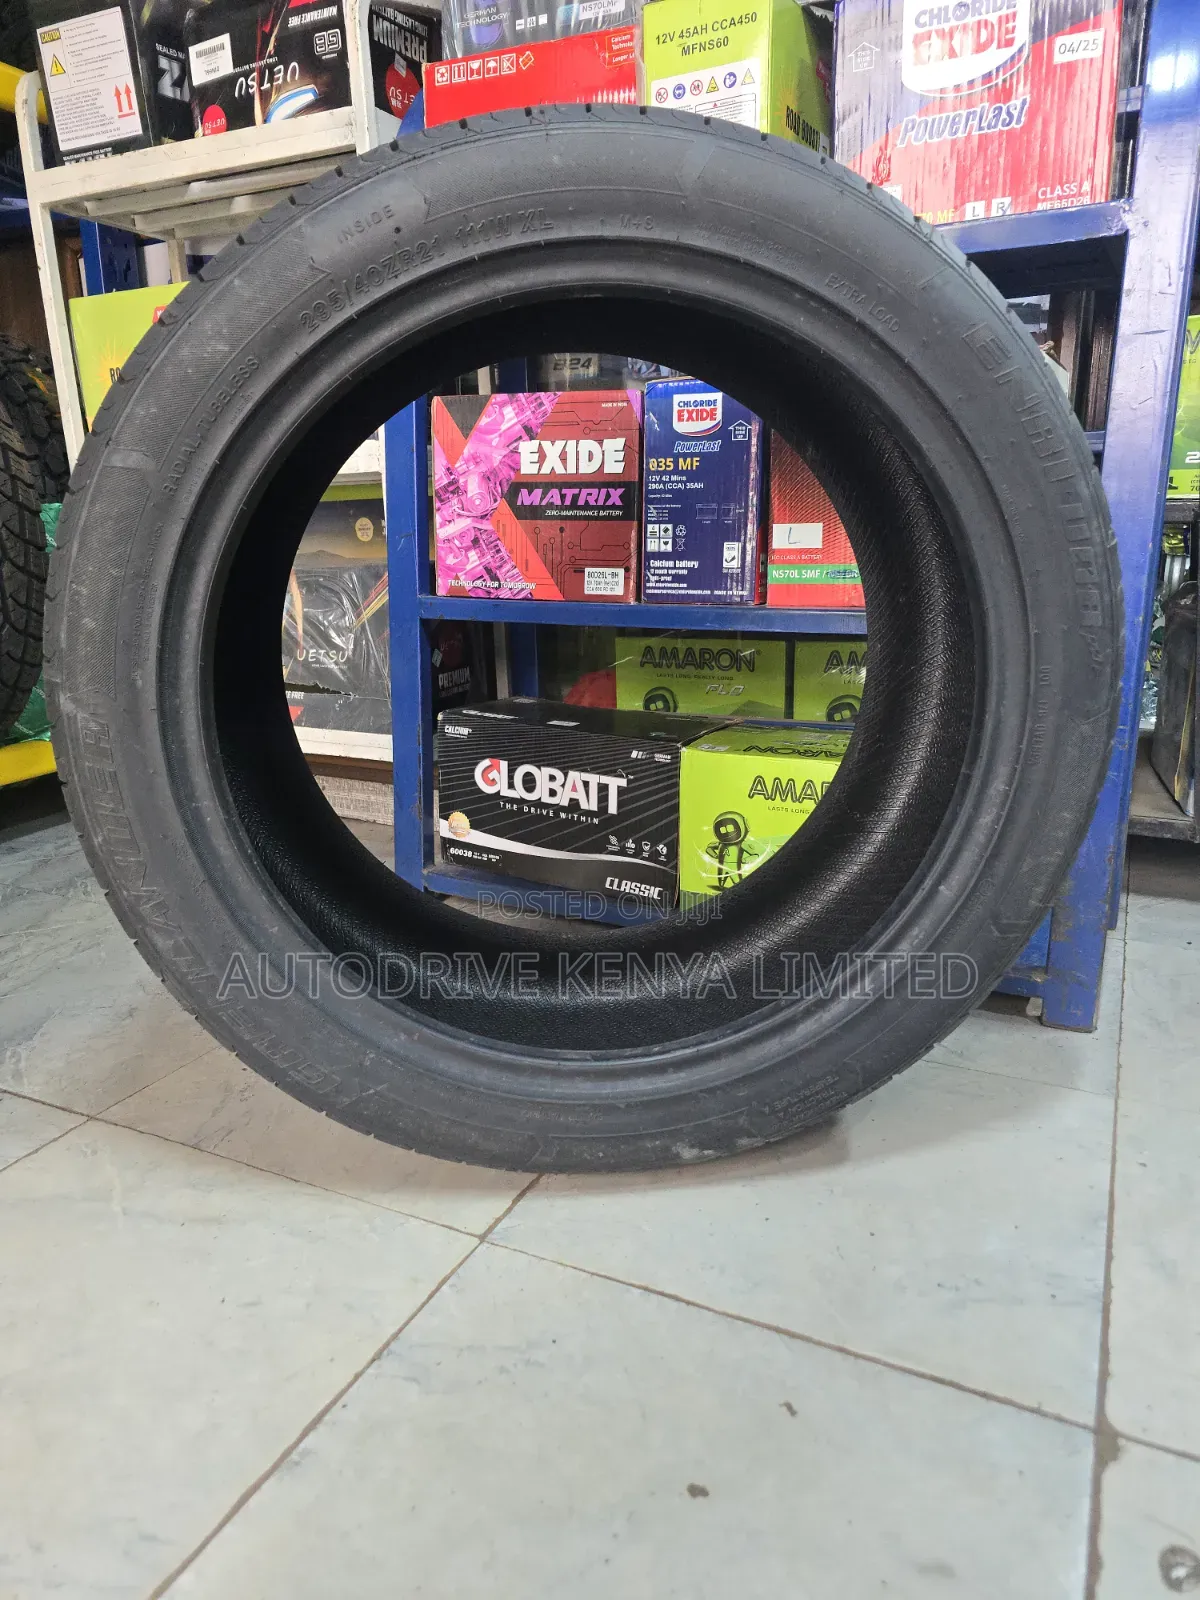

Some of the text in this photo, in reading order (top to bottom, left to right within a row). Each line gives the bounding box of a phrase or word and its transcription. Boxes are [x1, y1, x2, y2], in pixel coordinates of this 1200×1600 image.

[288, 14, 302, 27] FREE
[464, 6, 497, 18] GERMAN
[40, 30, 60, 42] CAUTION
[656, 12, 758, 46] 12V 45AH CCA450
[912, 10, 1018, 66] EXIDE
[372, 14, 428, 64] PREMIUM
[681, 36, 729, 56] MFNS60
[1058, 38, 1100, 56] 04/25
[156, 43, 177, 56] SEALED
[234, 62, 300, 99] UETSU
[204, 118, 225, 130] UETSU
[786, 105, 800, 136] ROAD
[1038, 181, 1091, 200] CLASS A
[937, 208, 955, 224] MF
[972, 206, 980, 218] L
[996, 202, 1008, 214] R
[338, 204, 395, 244] INSIDE
[518, 208, 554, 234] XL
[620, 214, 654, 230] M+S
[824, 273, 900, 333] EXTRA LOAD
[678, 399, 718, 408] CHLORIDE
[160, 350, 262, 497] RADIAL TUBELESS
[676, 408, 718, 422] EXIDE
[518, 438, 626, 474] EXIDE
[649, 457, 700, 470] 035 MF
[516, 488, 626, 506] MATRIX
[788, 526, 800, 544] L
[650, 560, 698, 568] Calcium battery
[772, 570, 800, 578] NS70L
[802, 570, 820, 578] SMF
[448, 580, 487, 588] TECHNOLOGY
[500, 581, 536, 590] TOMORROW
[297, 649, 348, 662] UETSU
[640, 645, 756, 672] AMARON
[438, 666, 470, 690] PREMIUM
[291, 692, 305, 700] FREE
[706, 684, 745, 696] FLO
[474, 757, 628, 814] GLOBATT
[748, 774, 832, 806] AMA
[500, 801, 600, 825] THE DRIVE WITHIN
[450, 847, 472, 858] 60038
[604, 876, 663, 900] CLASSIC
